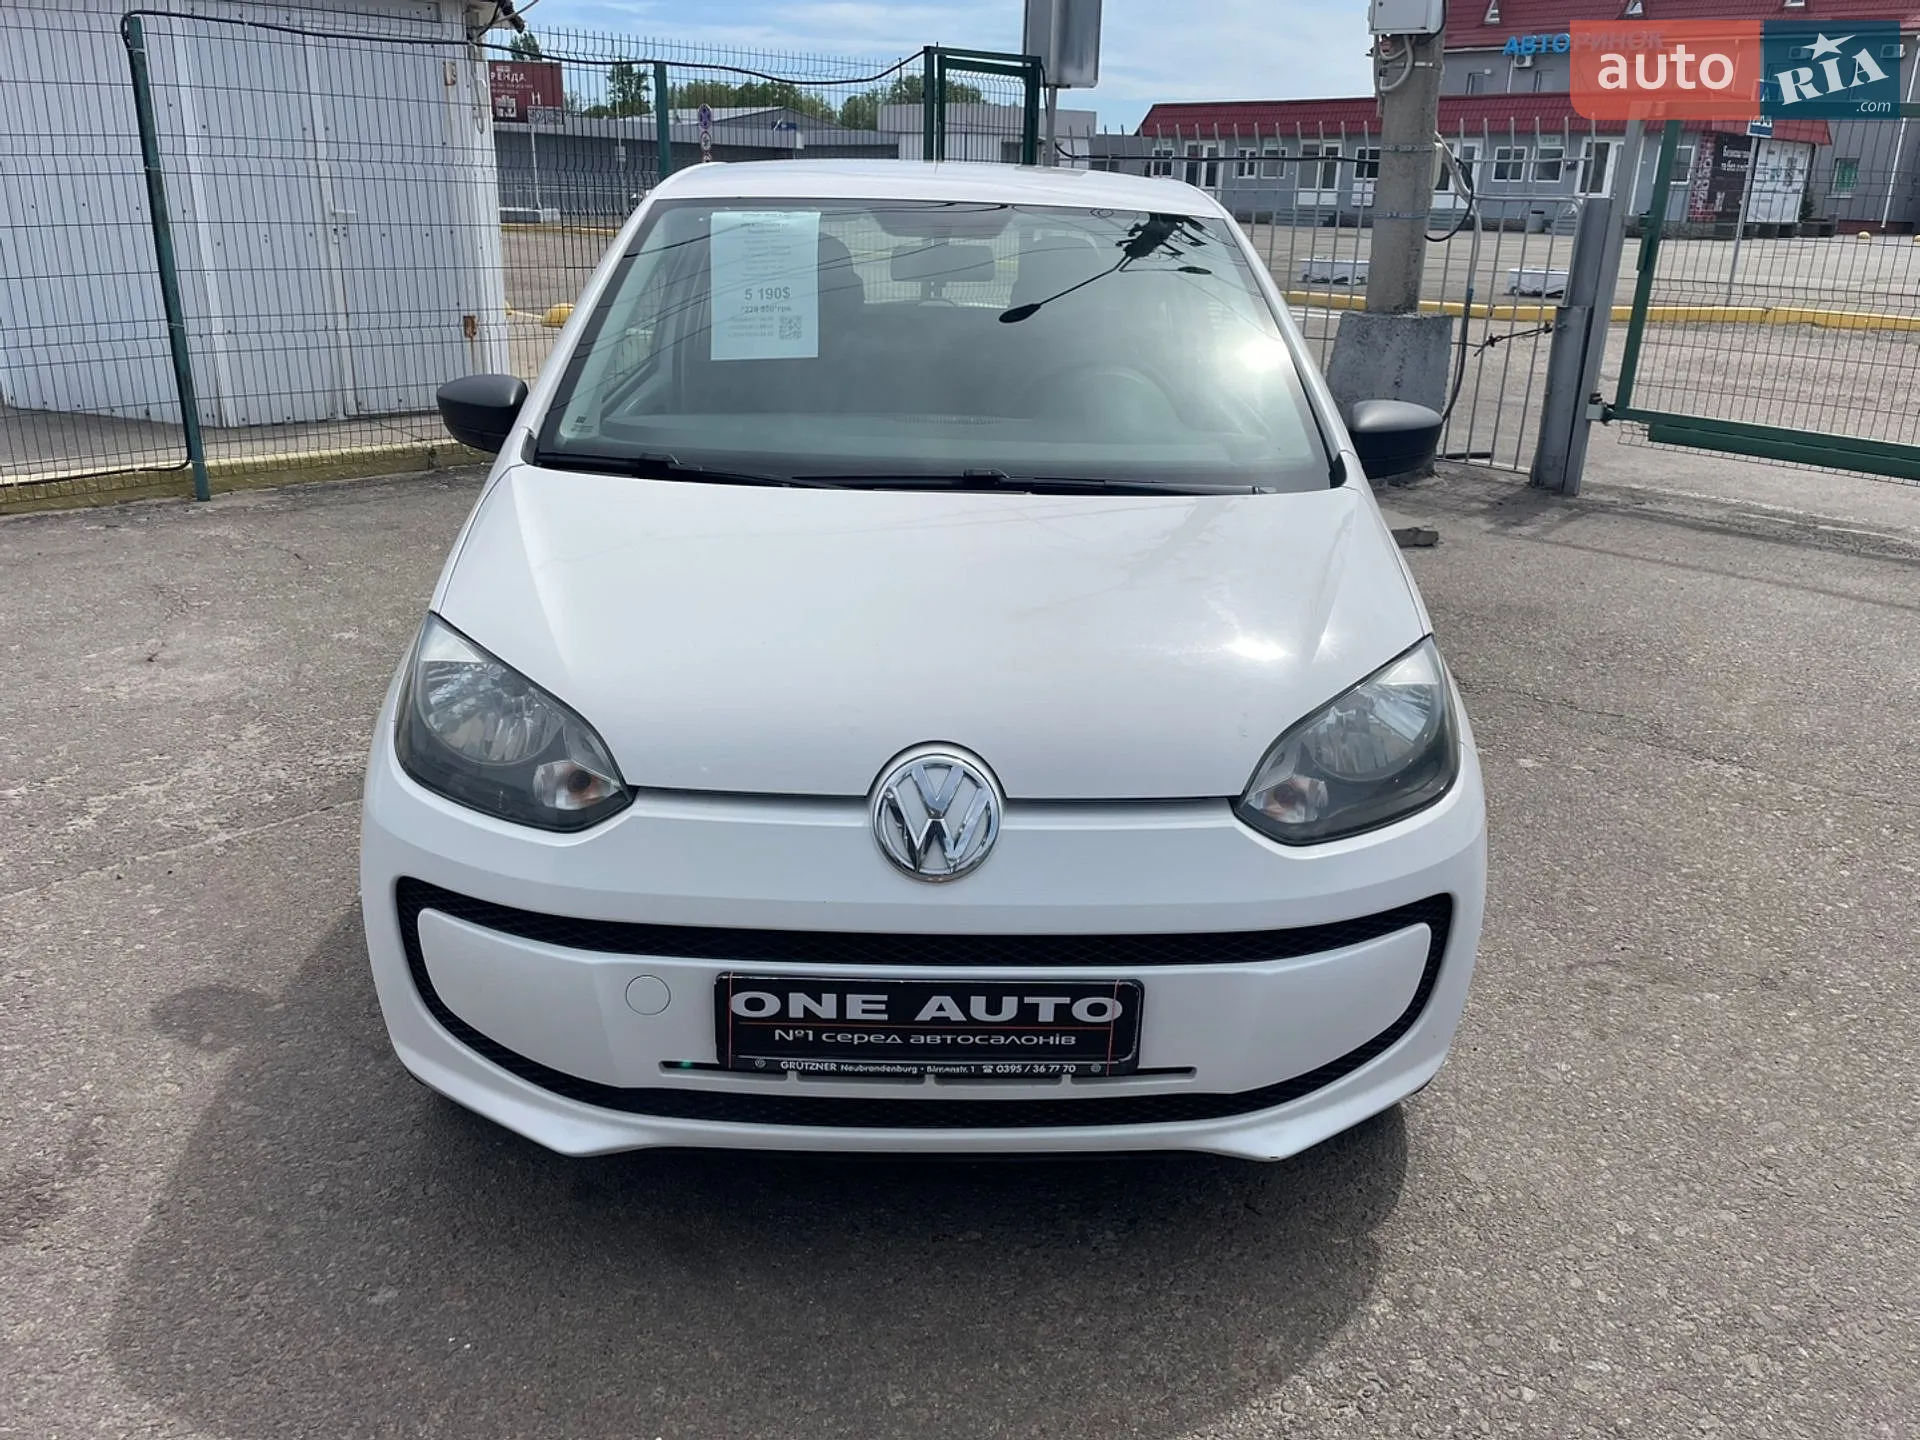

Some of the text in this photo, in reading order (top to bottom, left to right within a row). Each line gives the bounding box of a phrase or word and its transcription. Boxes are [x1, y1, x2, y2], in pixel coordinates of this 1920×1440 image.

[490, 71, 527, 83] РЕНДА
[730, 991, 1123, 1023] ONE AUTO
[821, 1032, 903, 1045] серед
[909, 1034, 1076, 1046] автосалонів
[996, 1064, 1022, 1074] 0395
[1032, 1065, 1046, 1074] 36
[1062, 1065, 1076, 1074] 70
